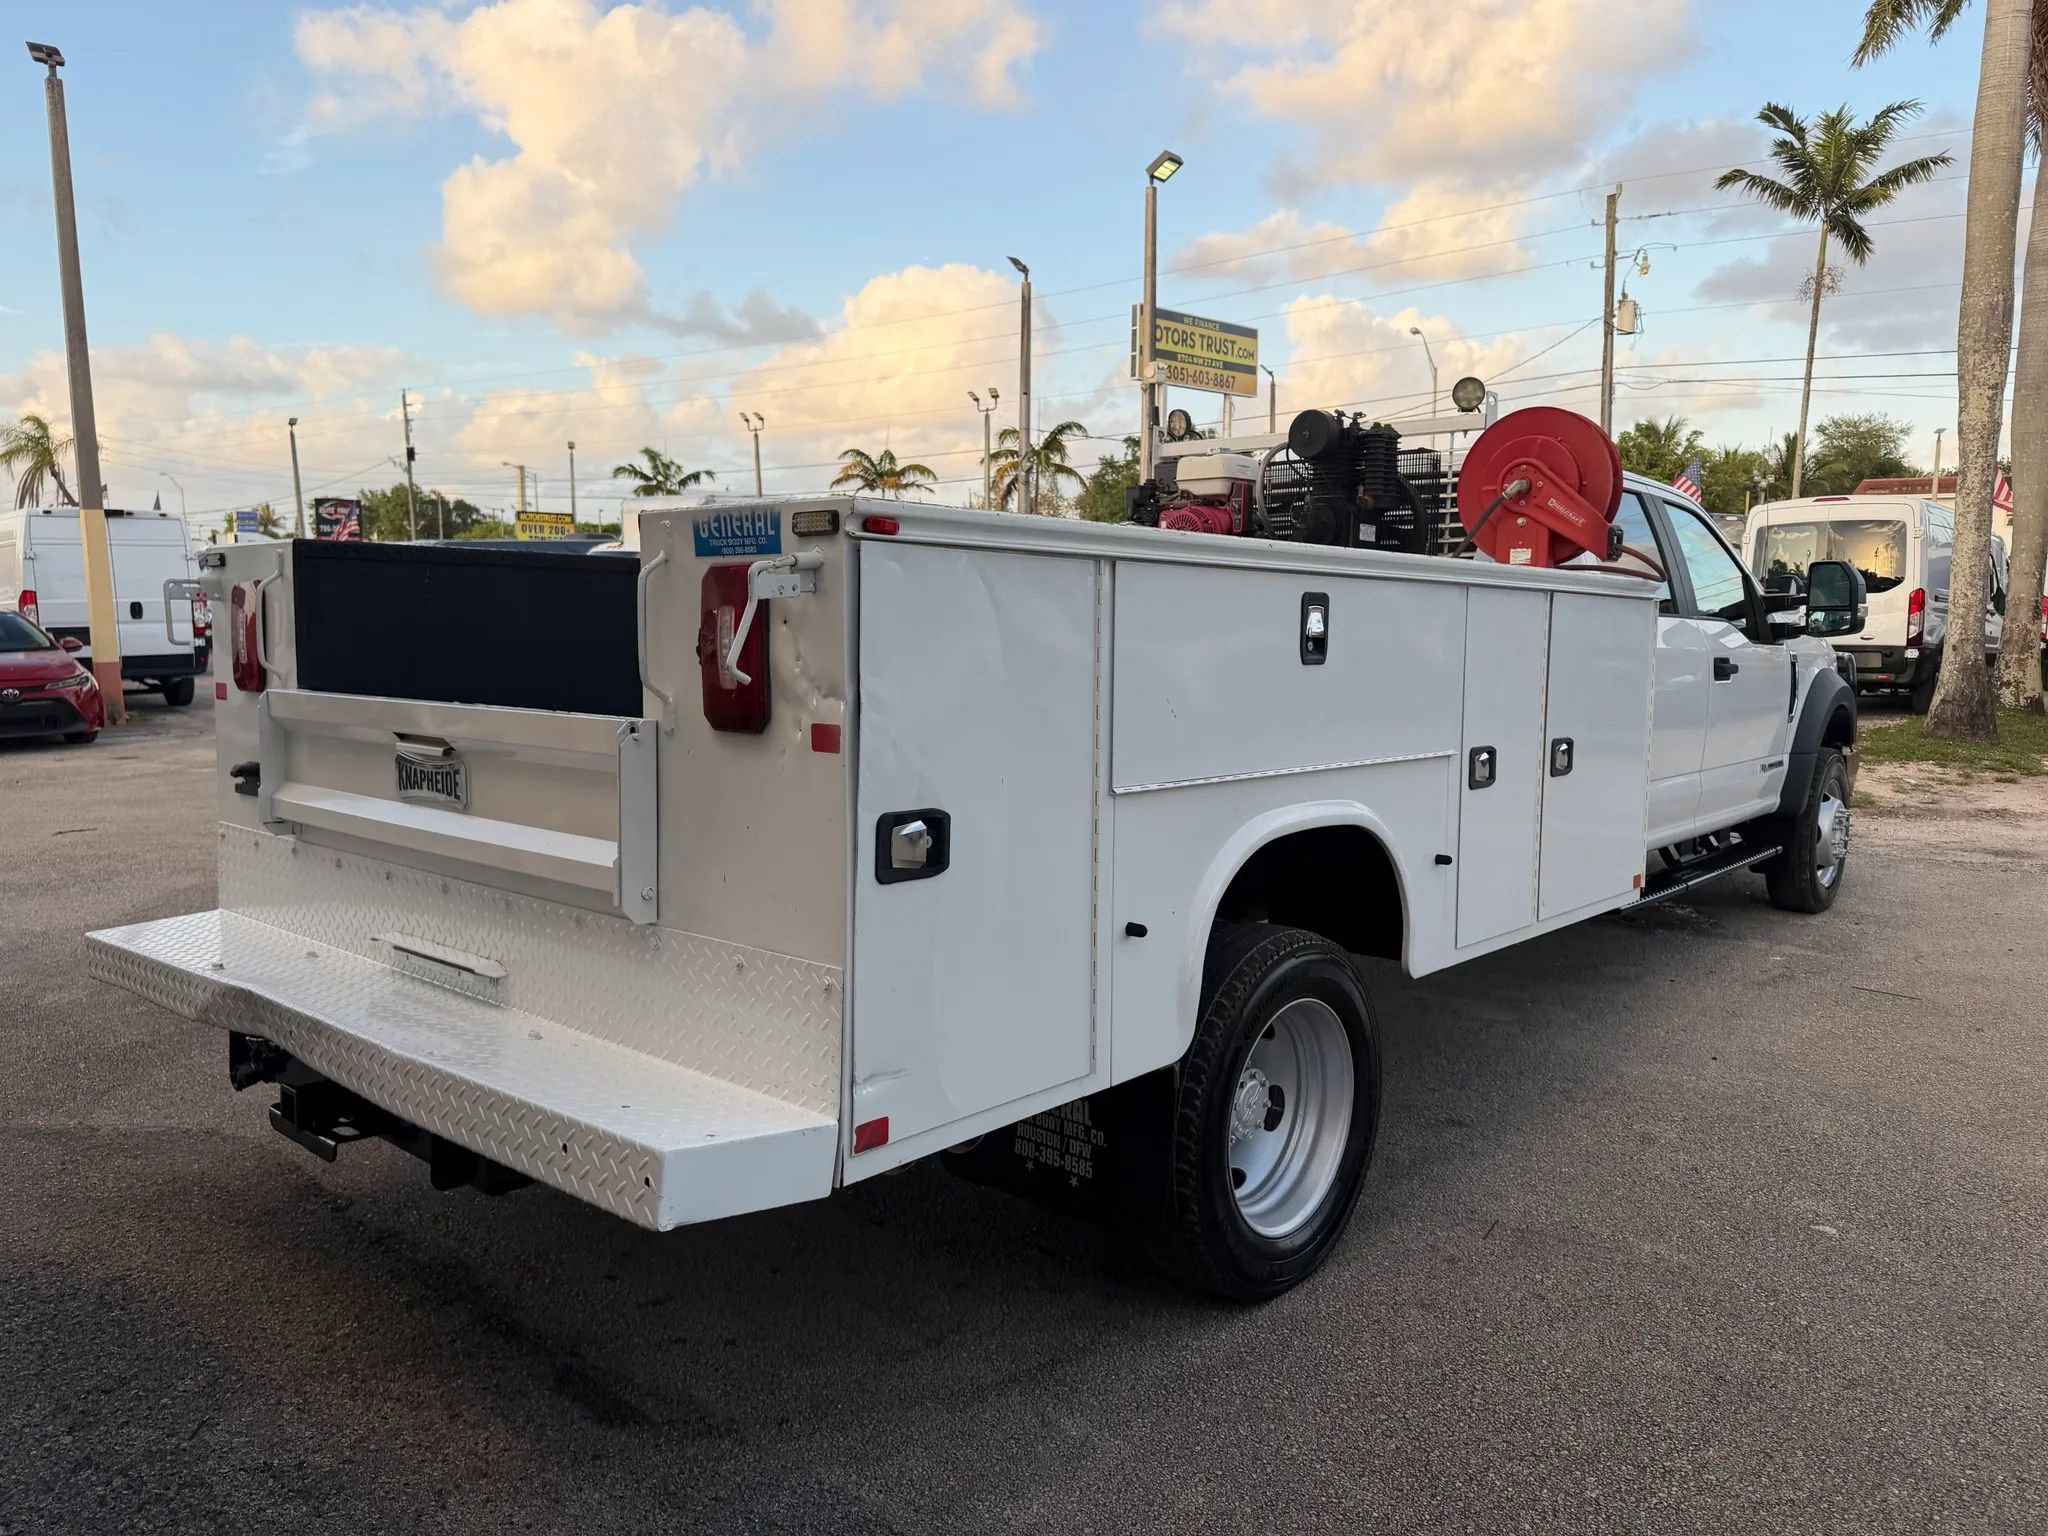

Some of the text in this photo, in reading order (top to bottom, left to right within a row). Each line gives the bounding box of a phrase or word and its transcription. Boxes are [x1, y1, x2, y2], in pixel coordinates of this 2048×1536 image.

[1183, 316, 1221, 331] WE FINANCE
[1155, 324, 1197, 349] OTORS
[1165, 365, 1236, 390] 305)-603-8867
[521, 524, 545, 533] OVER
[699, 510, 775, 538] GENERAL
[709, 538, 727, 547] TRUCK
[728, 538, 744, 546] BODY
[398, 760, 461, 801] KNAPHEIDE
[1017, 1122, 1060, 1149] HOUSTON
[1069, 1139, 1092, 1159] DFW
[1014, 1138, 1093, 1178] 800-395-8585
